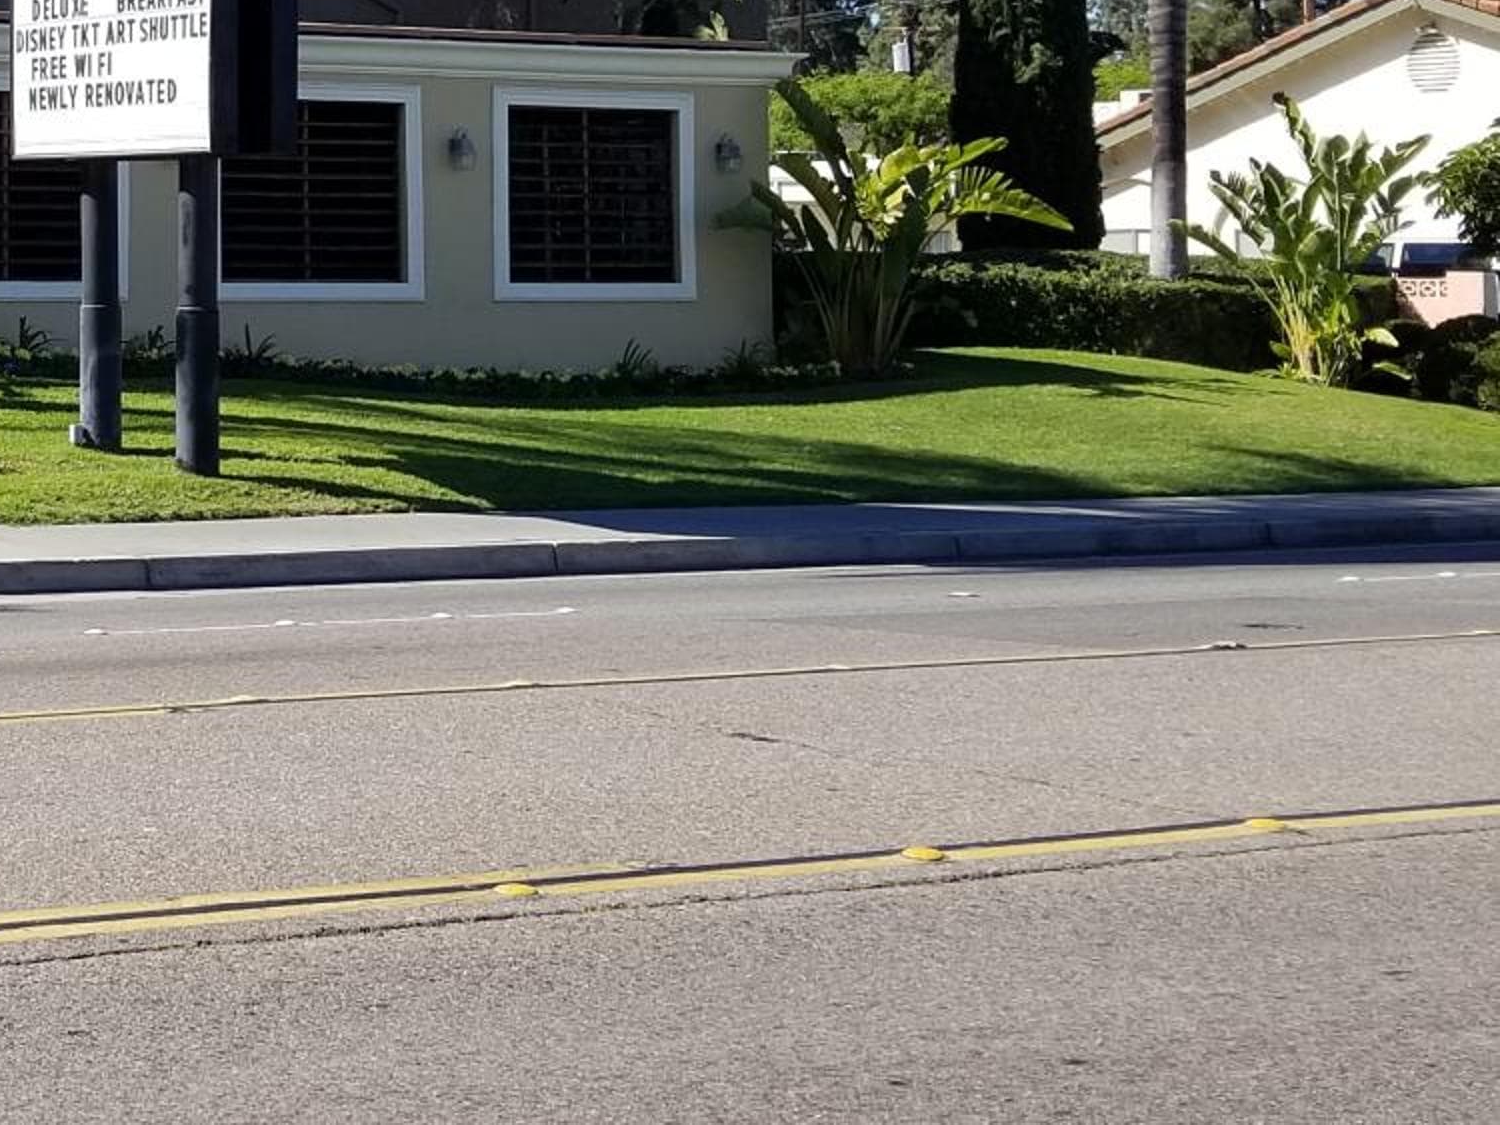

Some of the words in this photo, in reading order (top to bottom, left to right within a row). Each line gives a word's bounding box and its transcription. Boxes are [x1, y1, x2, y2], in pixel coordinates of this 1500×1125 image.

[16, 26, 66, 53] DISNEY
[73, 22, 100, 48] TKT
[105, 19, 135, 45] ART
[139, 13, 208, 43] SHUTTLE
[31, 56, 66, 81] FREE
[29, 85, 77, 111] NEWLY
[85, 78, 177, 108] RENOVATED
